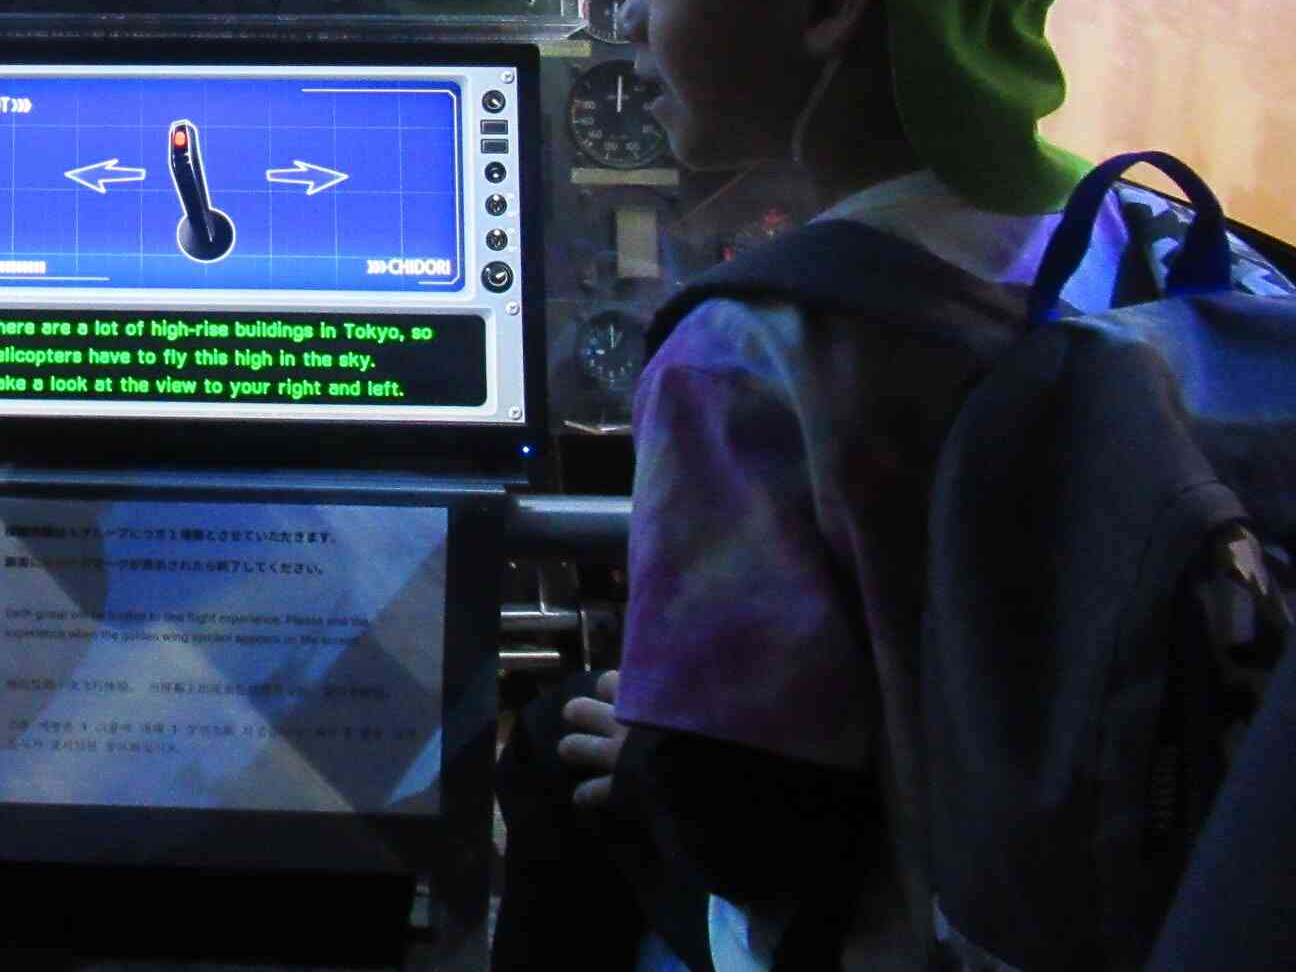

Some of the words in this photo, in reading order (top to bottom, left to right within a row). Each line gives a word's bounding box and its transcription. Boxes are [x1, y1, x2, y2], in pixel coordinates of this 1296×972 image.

[41, 322, 71, 335] are
[76, 323, 88, 335] a
[94, 320, 118, 336] lot
[125, 320, 144, 336] of
[151, 319, 229, 341] high-rise
[234, 321, 314, 342] buildings
[320, 323, 337, 338] in
[344, 323, 405, 344] Tokyo,
[411, 327, 433, 340] so
[88, 348, 131, 364] have
[137, 350, 156, 364] to
[163, 349, 187, 369] fly
[194, 348, 228, 366] this
[235, 349, 273, 370] high
[280, 350, 296, 366] in
[303, 351, 333, 367] the
[339, 352, 375, 372] sky.
[32, 378, 44, 391] a
[50, 376, 88, 392] look
[94, 378, 112, 392] at
[120, 377, 149, 393] the
[156, 376, 197, 393] view
[204, 379, 223, 394] to
[230, 381, 271, 398] your
[278, 379, 321, 400] right
[328, 381, 361, 396] and
[368, 381, 404, 396] left.
